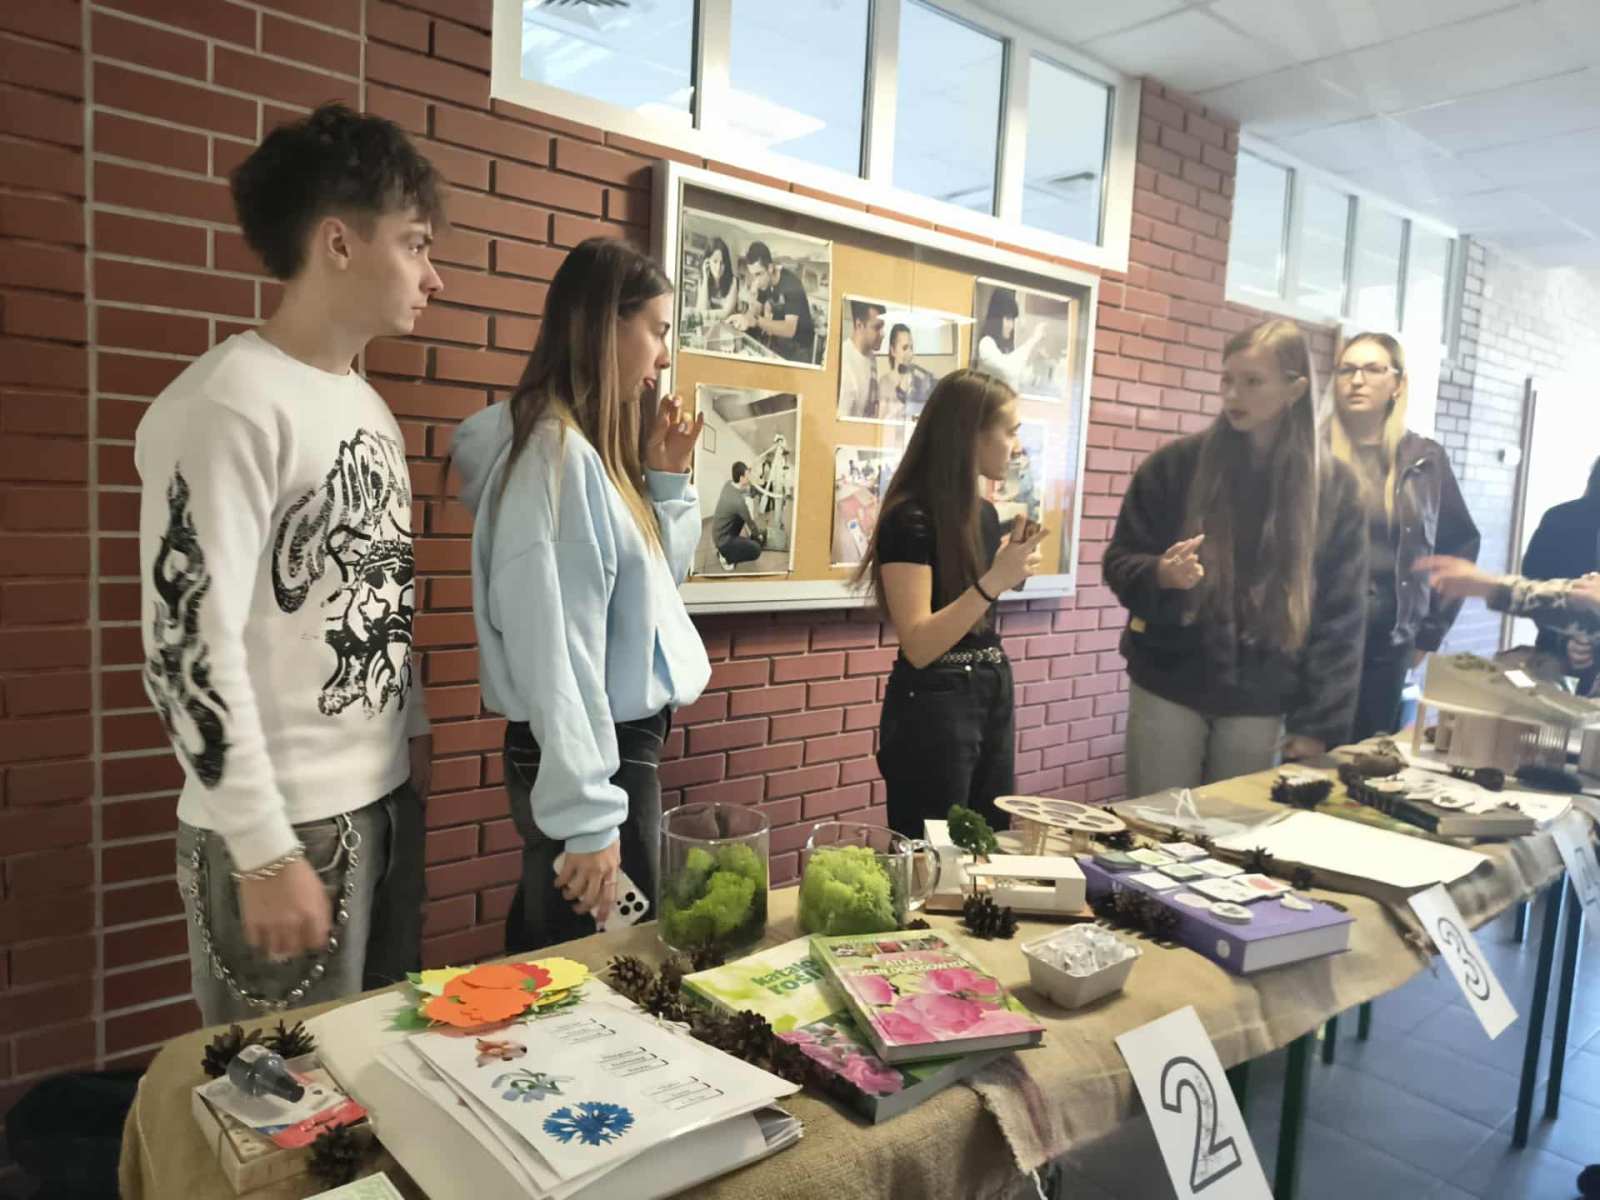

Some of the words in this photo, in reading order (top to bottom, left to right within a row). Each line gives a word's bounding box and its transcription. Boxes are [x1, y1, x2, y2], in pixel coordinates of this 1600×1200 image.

[751, 960, 820, 987] katalo
[884, 957, 926, 968] ATLAS
[1437, 917, 1490, 1001] 3
[1160, 1056, 1242, 1194] 2
